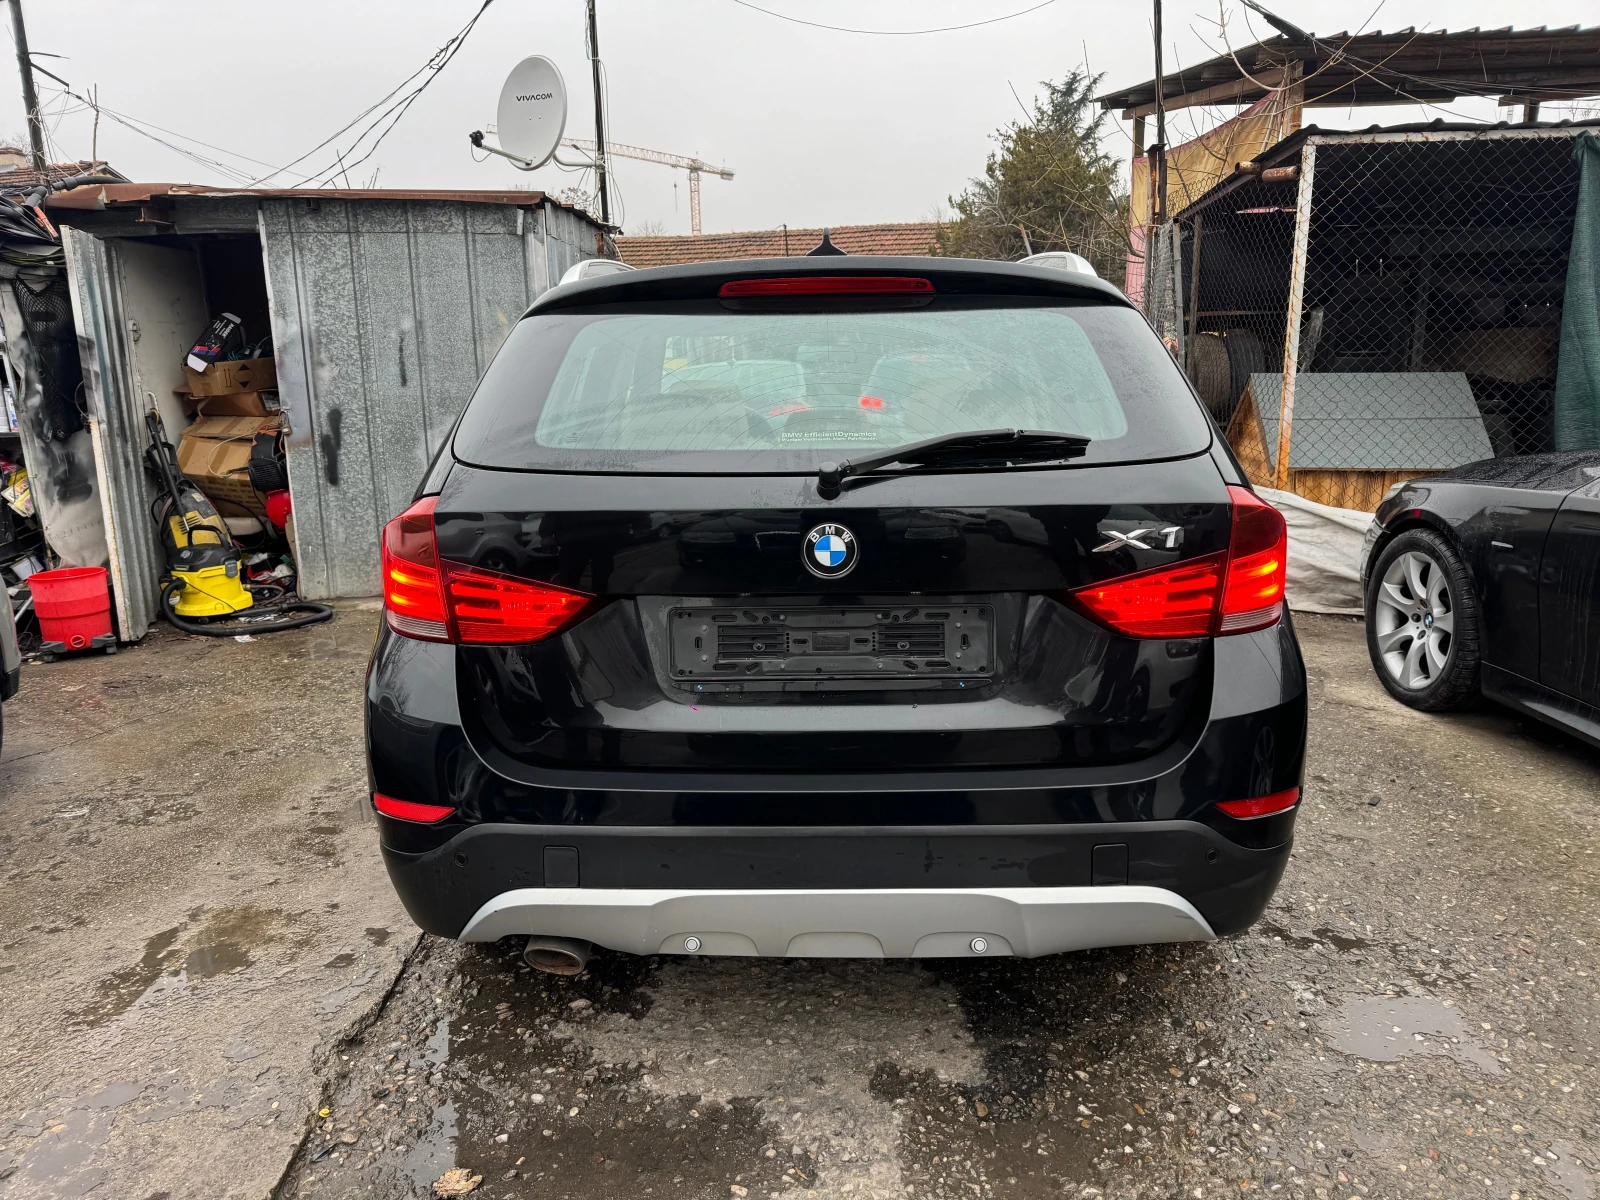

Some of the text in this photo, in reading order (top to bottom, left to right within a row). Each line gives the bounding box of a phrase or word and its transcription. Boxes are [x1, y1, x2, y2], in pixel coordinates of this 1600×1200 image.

[516, 93, 552, 101] VIVACOM
[809, 526, 852, 543] BMW
[1091, 526, 1184, 553] X1
